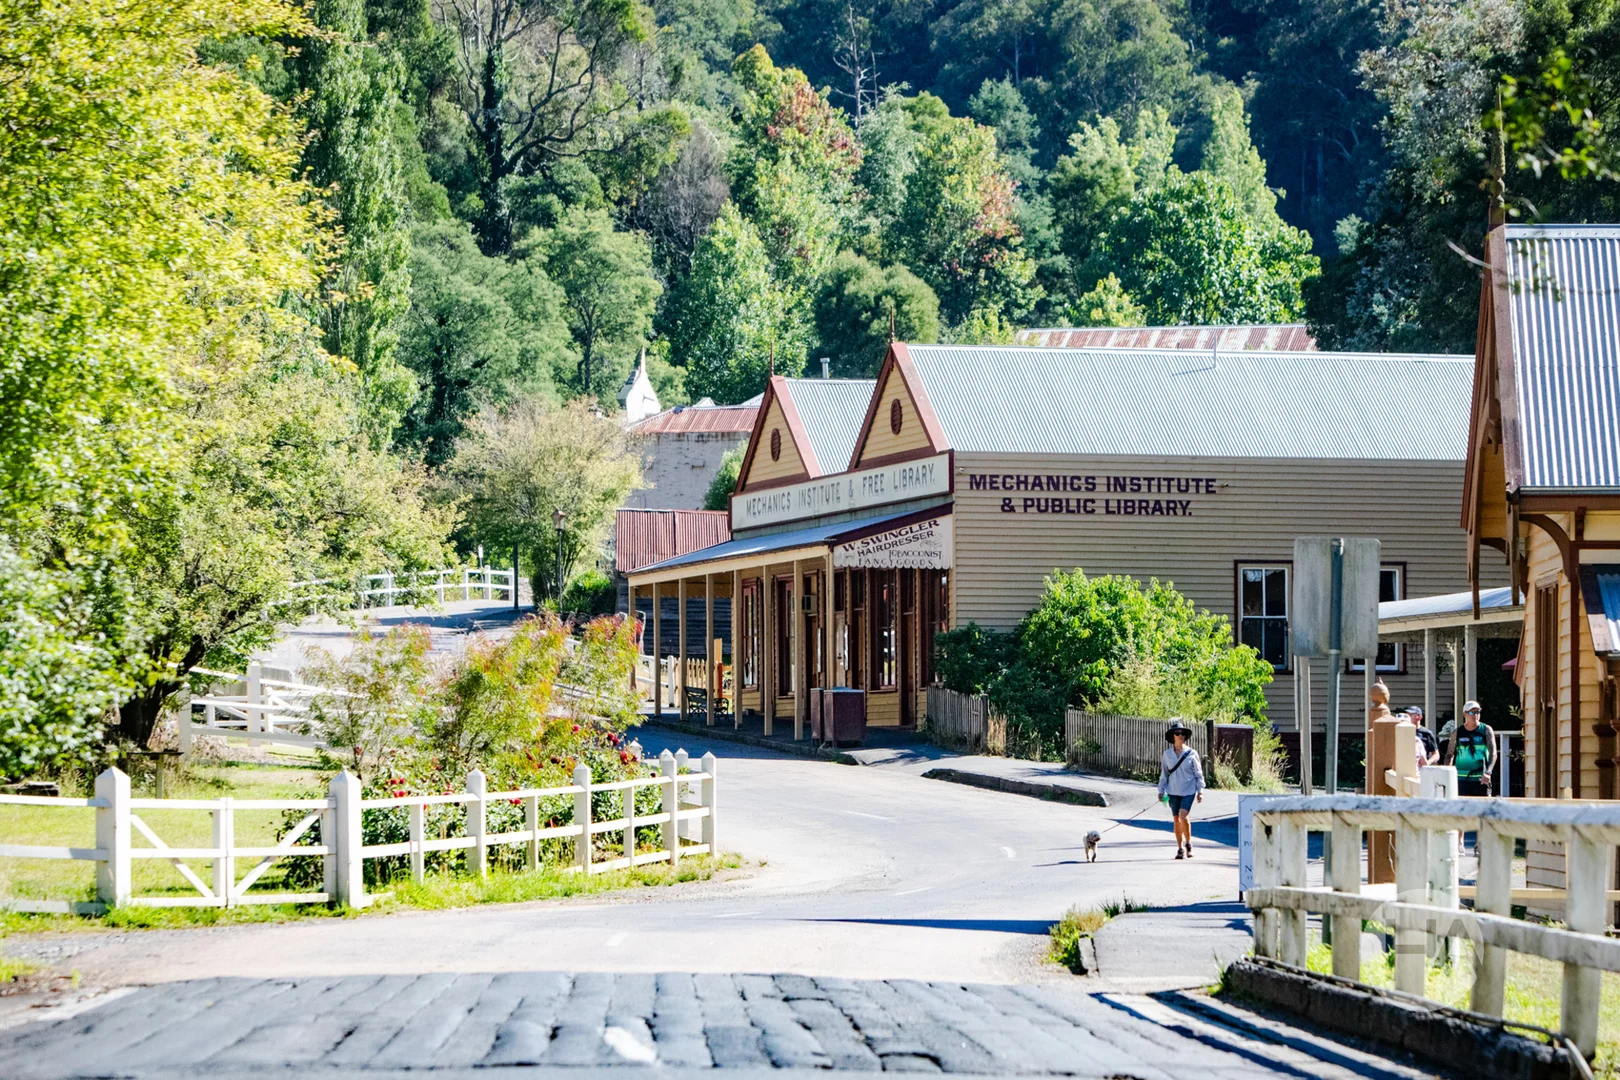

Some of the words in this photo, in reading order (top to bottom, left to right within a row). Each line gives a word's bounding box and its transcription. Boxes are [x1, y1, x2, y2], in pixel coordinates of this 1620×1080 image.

[746, 492, 791, 517] MECHANICS
[798, 482, 840, 507] INSTITUTE
[848, 480, 854, 498] &
[863, 473, 885, 496] FREE
[893, 463, 935, 490] LIBRARY.
[969, 474, 1097, 492] MECHANICS
[1106, 476, 1217, 494] INSTITUTE
[1000, 497, 1016, 513] &
[1023, 497, 1096, 514] PUBLIC
[1105, 500, 1192, 516] LIBRARY.
[857, 530, 934, 557] HAIRDRESSER
